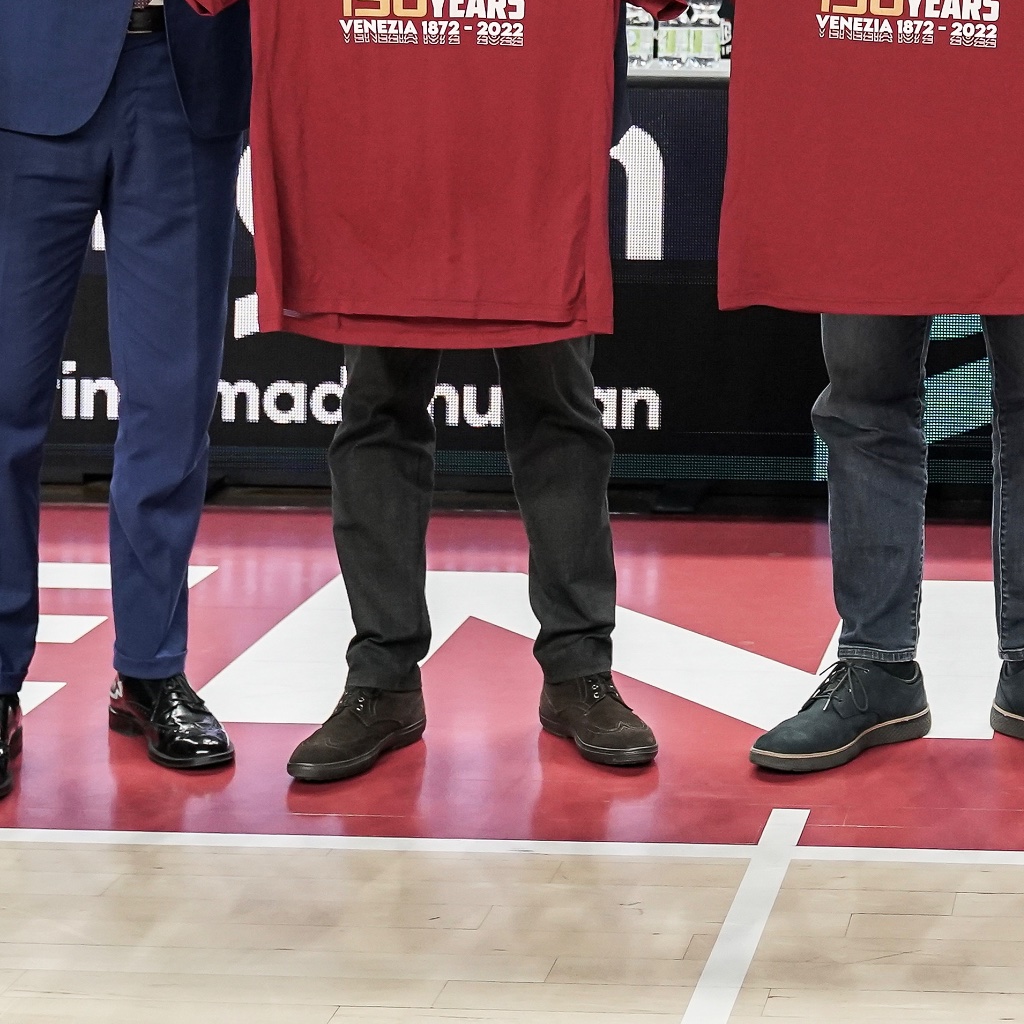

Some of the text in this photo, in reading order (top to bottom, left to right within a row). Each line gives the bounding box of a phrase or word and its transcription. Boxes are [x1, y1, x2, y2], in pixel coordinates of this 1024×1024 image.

[339, 19, 418, 35] VENEZIA
[421, 21, 460, 35] 1872
[476, 21, 524, 37] 2022
[816, 14, 892, 35] VENEZIA
[897, 19, 934, 35] 1872
[950, 22, 997, 39] 2022
[217, 365, 347, 423] mad
